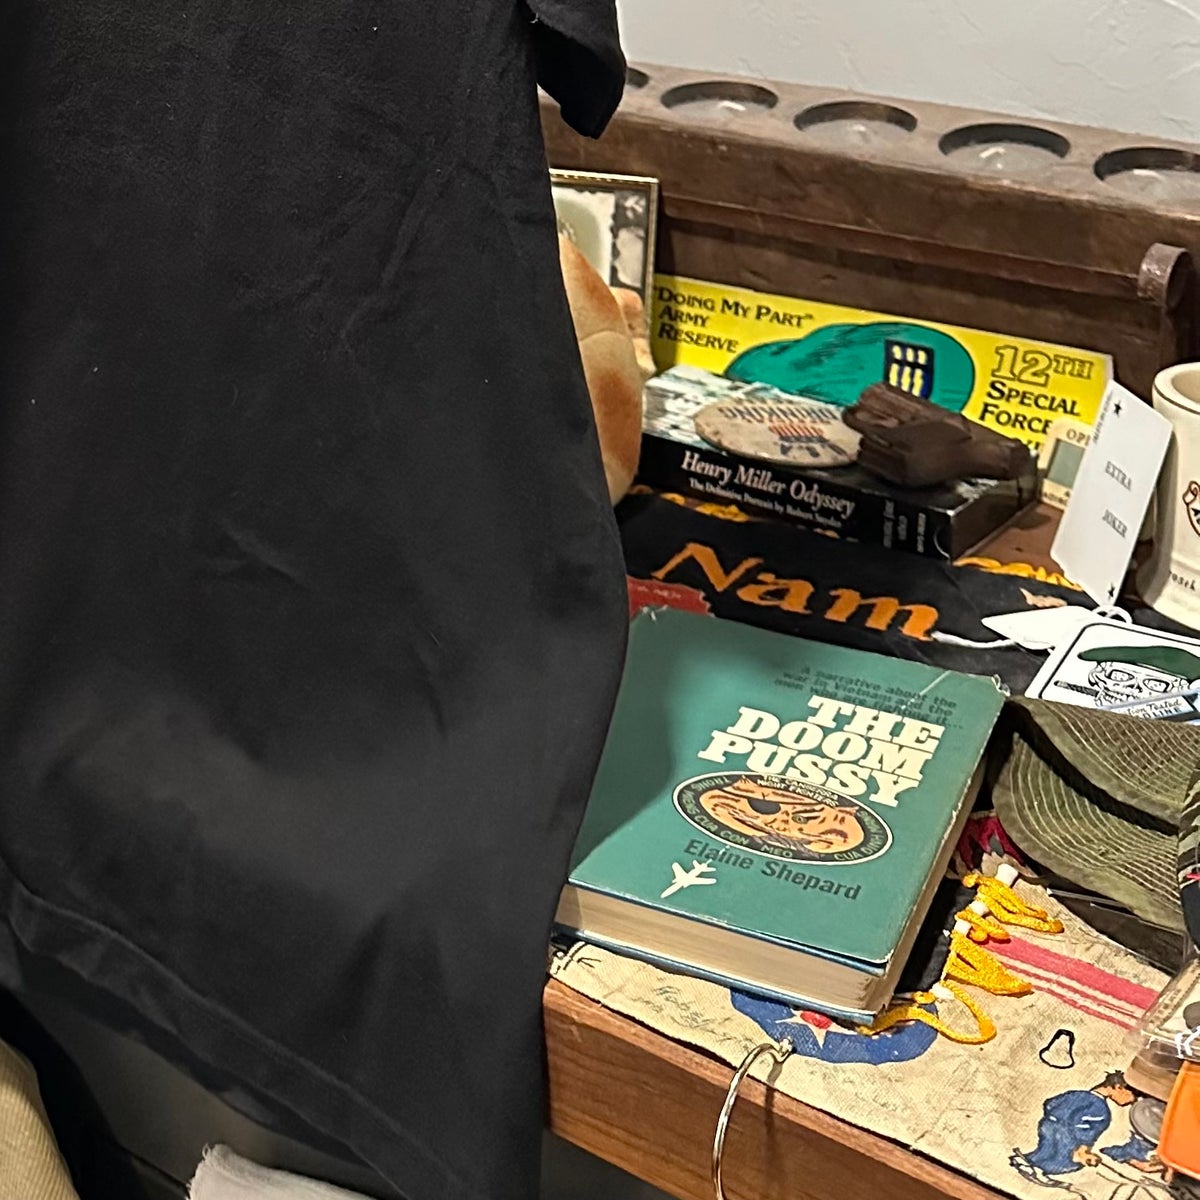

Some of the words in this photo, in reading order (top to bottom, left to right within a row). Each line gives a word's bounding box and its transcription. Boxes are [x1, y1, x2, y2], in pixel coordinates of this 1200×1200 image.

[681, 449, 733, 486] Henry
[734, 464, 786, 496] Miller
[789, 479, 856, 519] Odyssey
[1104, 460, 1133, 492] EXTRA
[650, 542, 940, 643] Nam
[725, 706, 936, 783] DOOM
[807, 694, 947, 754] THE
[696, 729, 922, 808] PUSSY
[684, 837, 755, 871] Elaine
[760, 859, 863, 901] Shepard
[720, 829, 750, 846] CON
